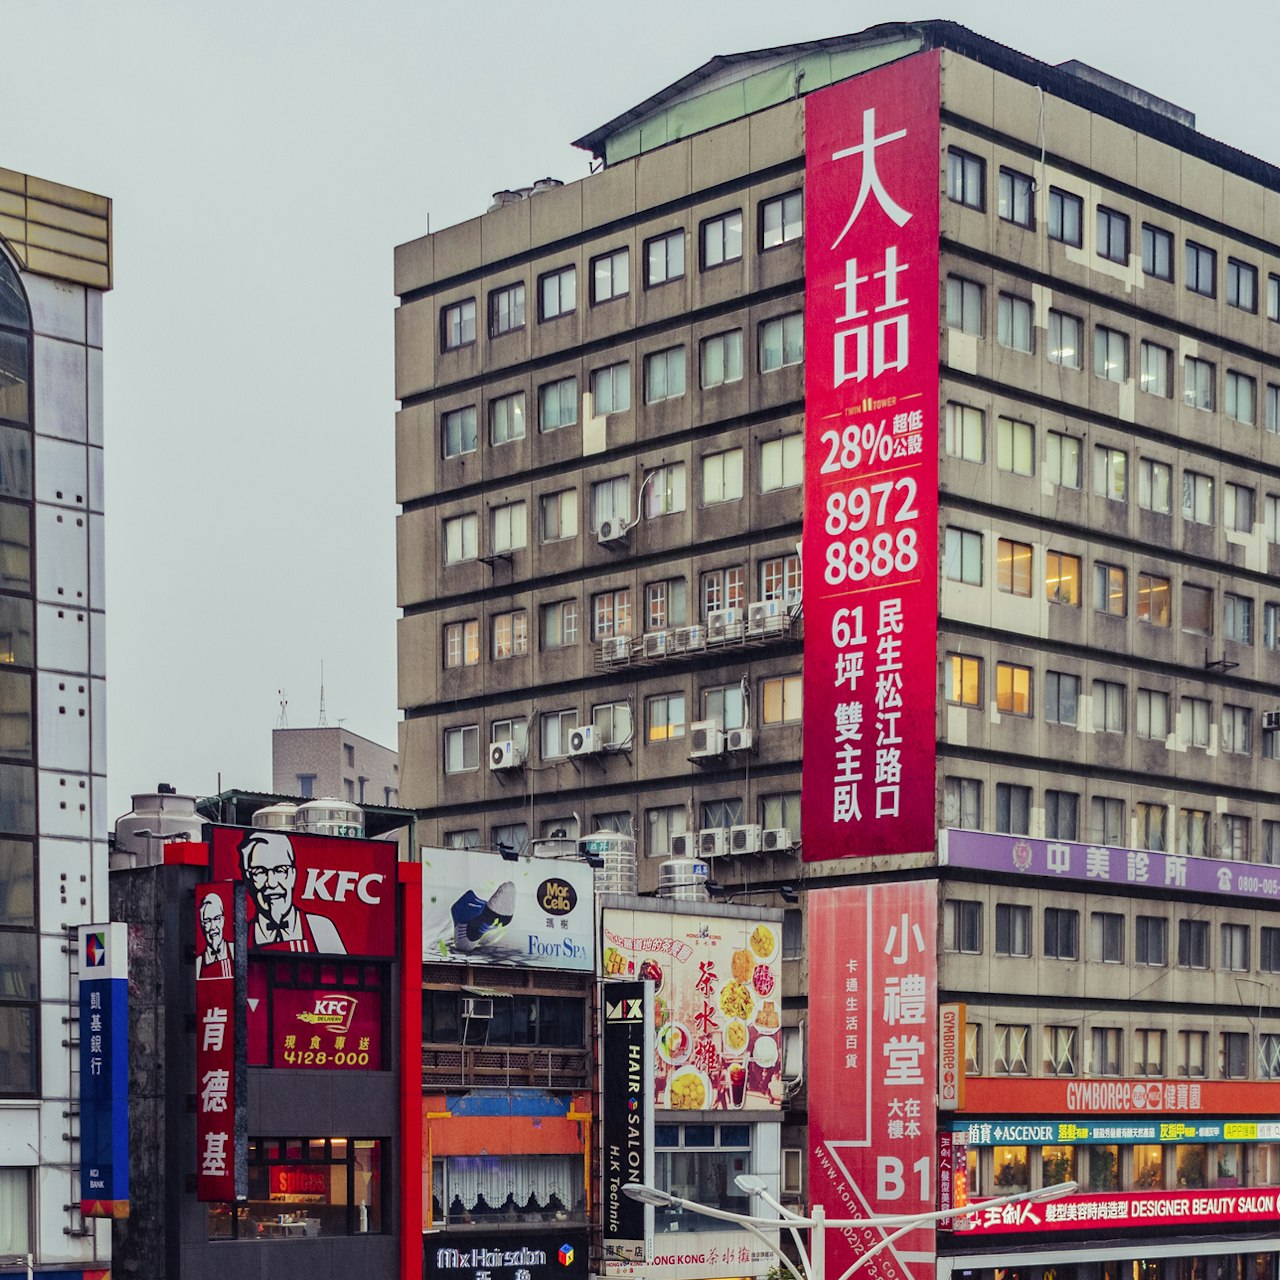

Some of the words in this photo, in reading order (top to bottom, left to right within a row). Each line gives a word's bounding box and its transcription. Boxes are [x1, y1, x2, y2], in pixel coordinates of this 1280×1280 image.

[830, 107, 914, 390] 大喆
[844, 403, 862, 415] TWIN
[873, 396, 897, 411] TOWER
[892, 410, 923, 433] 超低
[820, 419, 894, 475] 28%
[892, 433, 923, 457] 公設
[824, 476, 919, 537] 8972
[823, 527, 918, 586] 8888
[831, 605, 868, 692] 61坪
[874, 598, 904, 819] 民生松江路口
[832, 701, 863, 824] 雙主臥
[302, 867, 387, 905] KFC
[1046, 842, 1188, 888] 中美診所
[313, 998, 348, 1017] KFC
[694, 960, 719, 1073] 茶水攤
[845, 959, 859, 1069] 卡通生活百貨
[882, 912, 926, 1086] 小禮堂
[90, 992, 103, 1076] 凱基銀行
[284, 1033, 371, 1052] 現食專送
[283, 1050, 370, 1067] 4128-000
[628, 1044, 641, 1094] HAIR
[201, 1006, 230, 1178] 肯德基
[1164, 1083, 1201, 1110] 健寶園
[627, 1113, 641, 1184] SALON
[968, 1123, 992, 1144] 植寶
[1001, 1126, 1053, 1141] ASCENDER
[89, 1169, 100, 1178] KGI
[610, 1145, 619, 1171] H.K
[876, 1155, 931, 1201] B1
[89, 1180, 105, 1190] BANK
[610, 1174, 621, 1233] Technic
[1131, 1199, 1190, 1218] DESIGNER
[1192, 1197, 1236, 1214] BEAUTY
[1237, 1194, 1273, 1211] SALON
[606, 1244, 644, 1258] 南京一店
[652, 1255, 676, 1266] ONG
[677, 1253, 706, 1265] KONG
